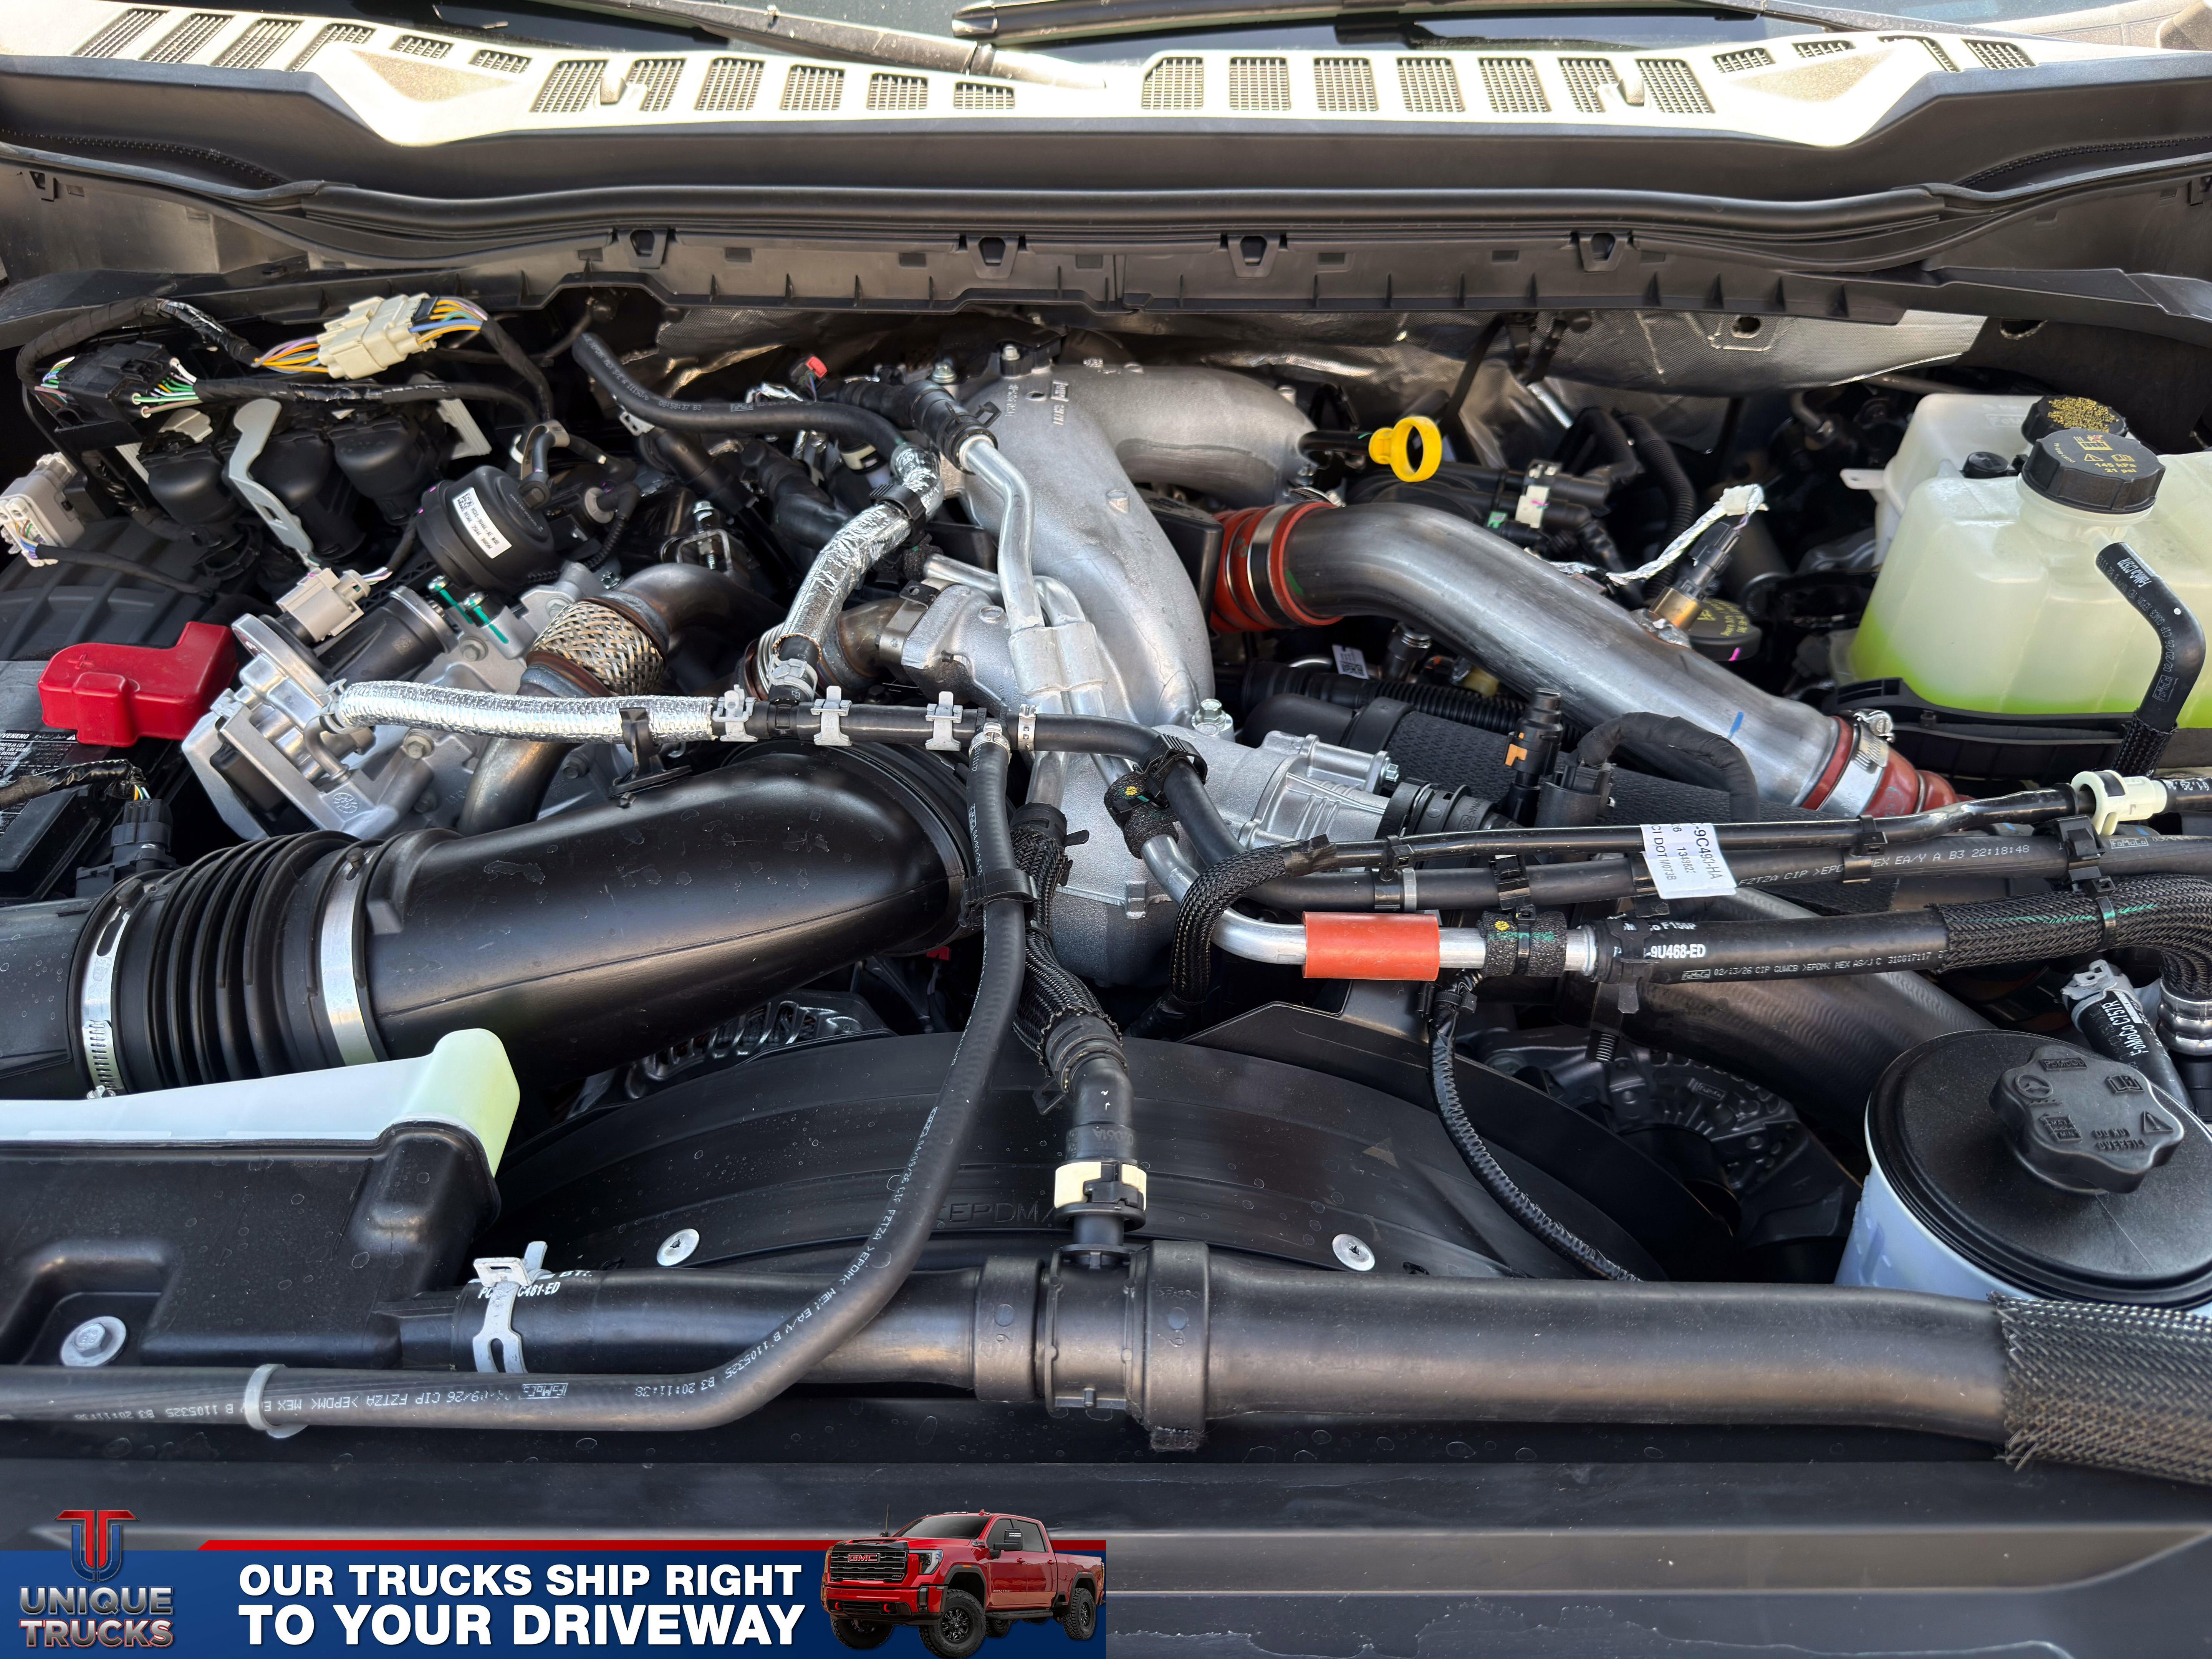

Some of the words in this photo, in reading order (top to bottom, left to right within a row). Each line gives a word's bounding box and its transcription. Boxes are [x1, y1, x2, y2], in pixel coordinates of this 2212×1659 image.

[2162, 639, 2174, 672] 02/20/26
[1654, 838, 1667, 858] DOT
[1690, 823, 1723, 879] -9C493-HA
[1783, 870, 1808, 880] CIP
[1932, 853, 1941, 861] A
[1949, 849, 1965, 860] B3
[1971, 845, 2030, 858] 22:18:48
[1714, 967, 1752, 976] 02/13/26
[1755, 966, 1769, 975] CIP
[1835, 960, 1851, 969] MEX
[2101, 1000, 2131, 1026] C757R
[2119, 1024, 2149, 1056] FoMoCo
[839, 1245, 875, 1285] >EPDM<
[773, 1331, 782, 1342] B
[725, 1341, 768, 1379] 1105325
[634, 1382, 696, 1397] 20:11:38
[700, 1376, 716, 1390] B3
[277, 1399, 302, 1411] MEX
[310, 1395, 359, 1410] >EPDM<
[414, 1391, 440, 1404] CIP
[137, 1409, 155, 1419] B3
[165, 1404, 218, 1418] 1105325
[225, 1403, 233, 1414] B
